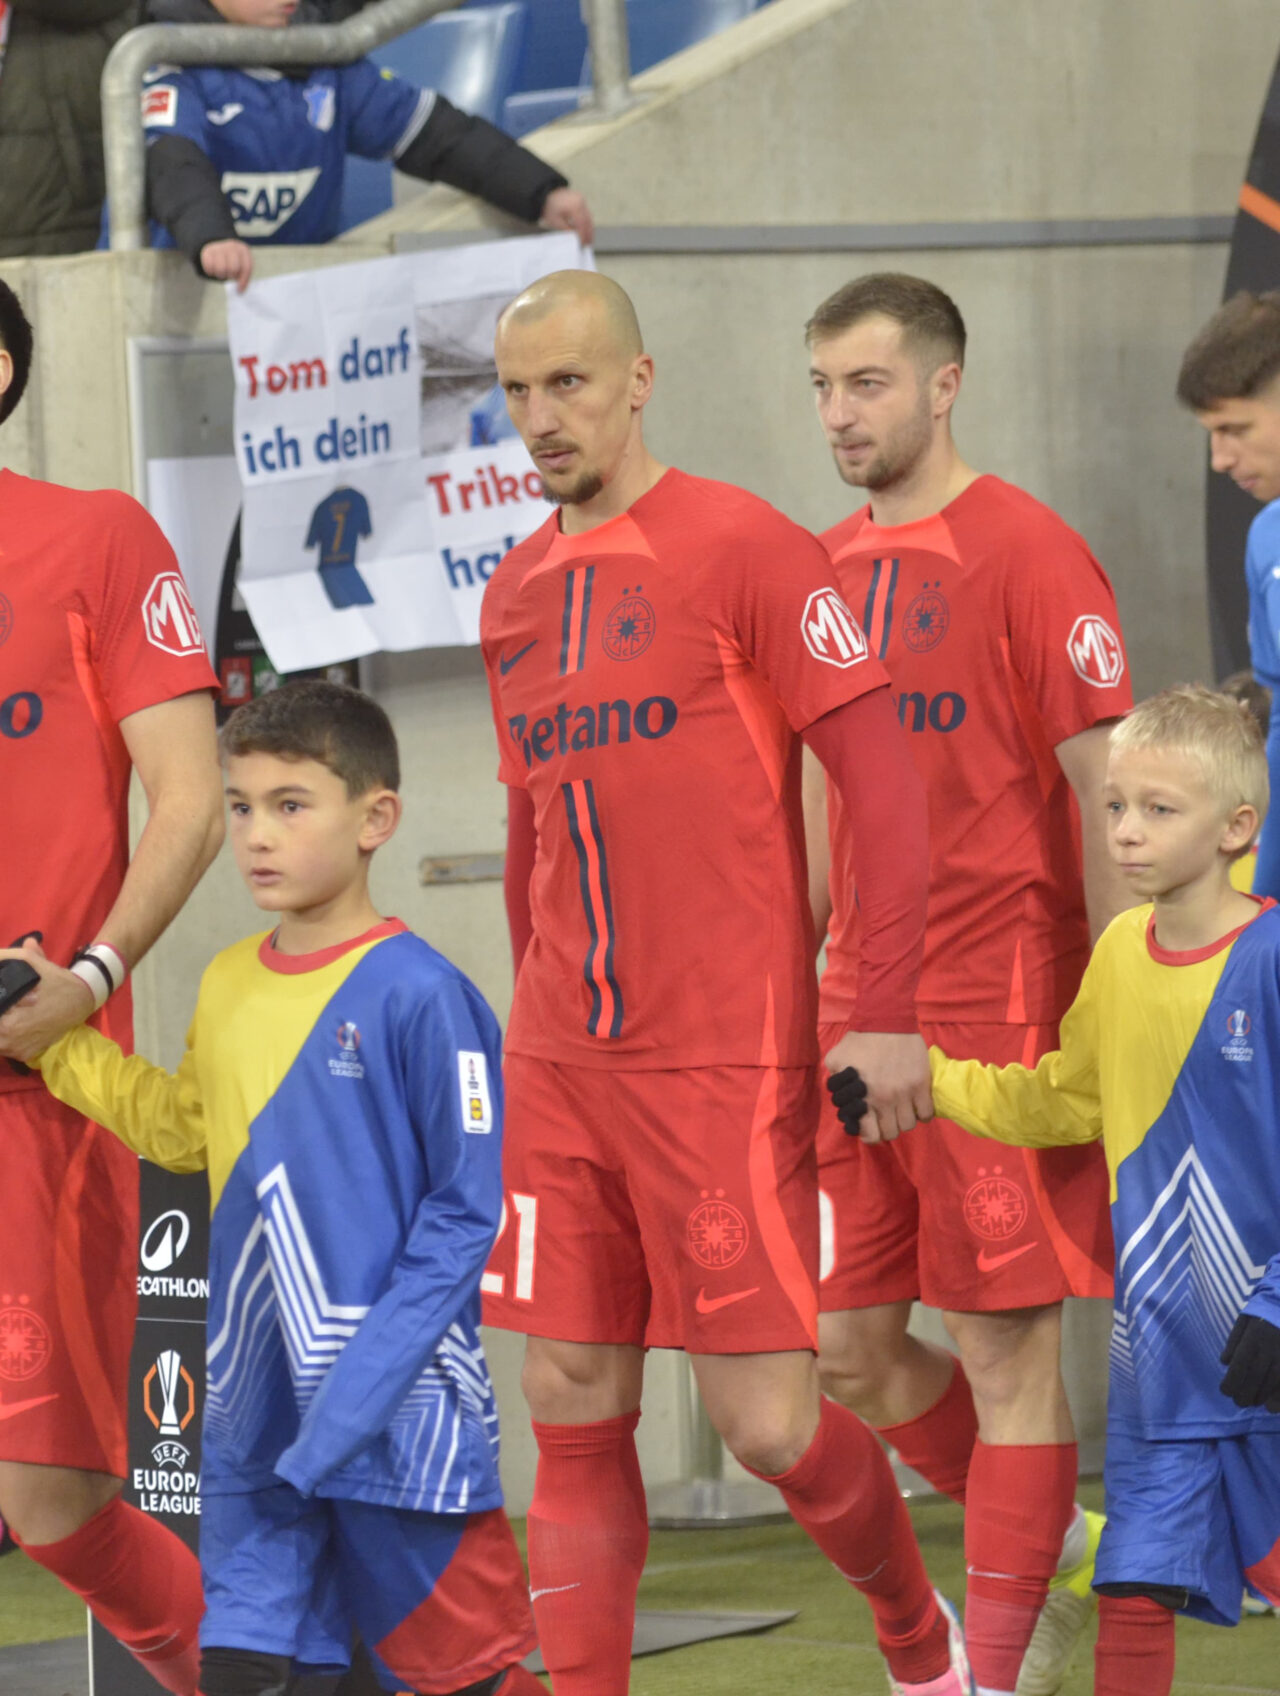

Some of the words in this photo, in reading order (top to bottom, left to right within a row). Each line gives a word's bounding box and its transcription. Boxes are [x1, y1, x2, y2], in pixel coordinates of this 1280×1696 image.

[227, 186, 296, 224] SAP
[239, 355, 327, 399] Tom
[340, 326, 410, 383] darf
[242, 432, 301, 475] ich
[315, 413, 391, 464] dein
[1074, 621, 1119, 681] MG
[508, 695, 678, 769] Betano
[153, 1445, 187, 1466] UEFA
